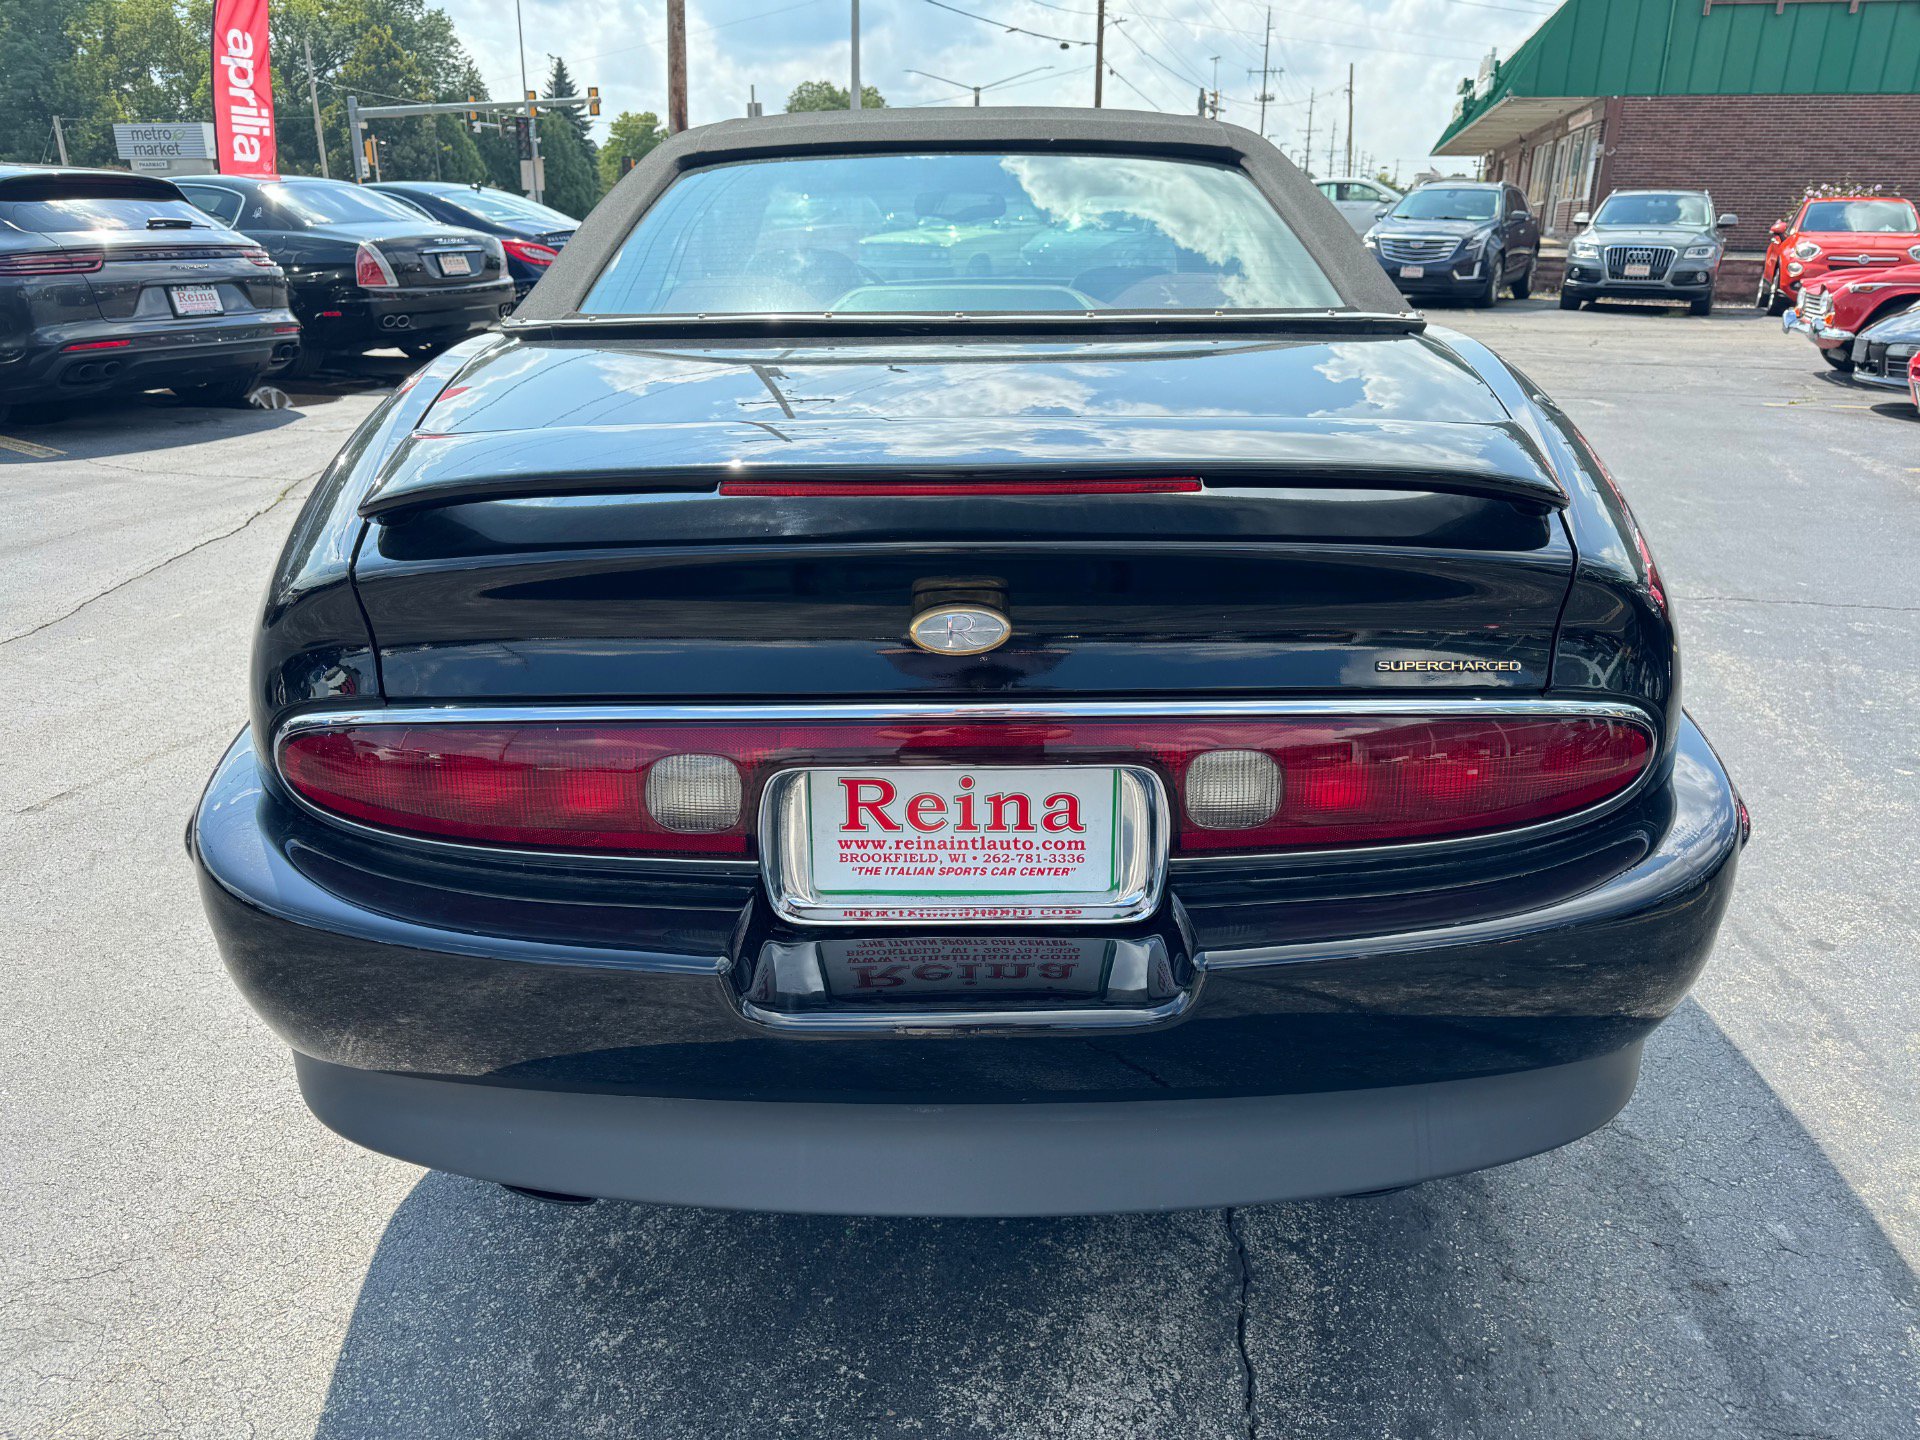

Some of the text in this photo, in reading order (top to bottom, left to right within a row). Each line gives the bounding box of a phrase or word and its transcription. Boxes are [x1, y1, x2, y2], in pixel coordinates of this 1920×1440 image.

[220, 28, 270, 163] aprilia
[131, 127, 172, 140] metro
[134, 142, 181, 155] market
[177, 291, 216, 303] Reina
[1377, 660, 1522, 671] SUPERCHARGED
[837, 775, 1087, 833] Reina
[837, 836, 1086, 850] www.reinaintlauto.com
[839, 853, 1085, 865] BROOKFIELD, WI 262-781-3336
[885, 867, 935, 876] ITALIAN
[938, 867, 987, 876] SPORTS
[990, 867, 1017, 876] CAR
